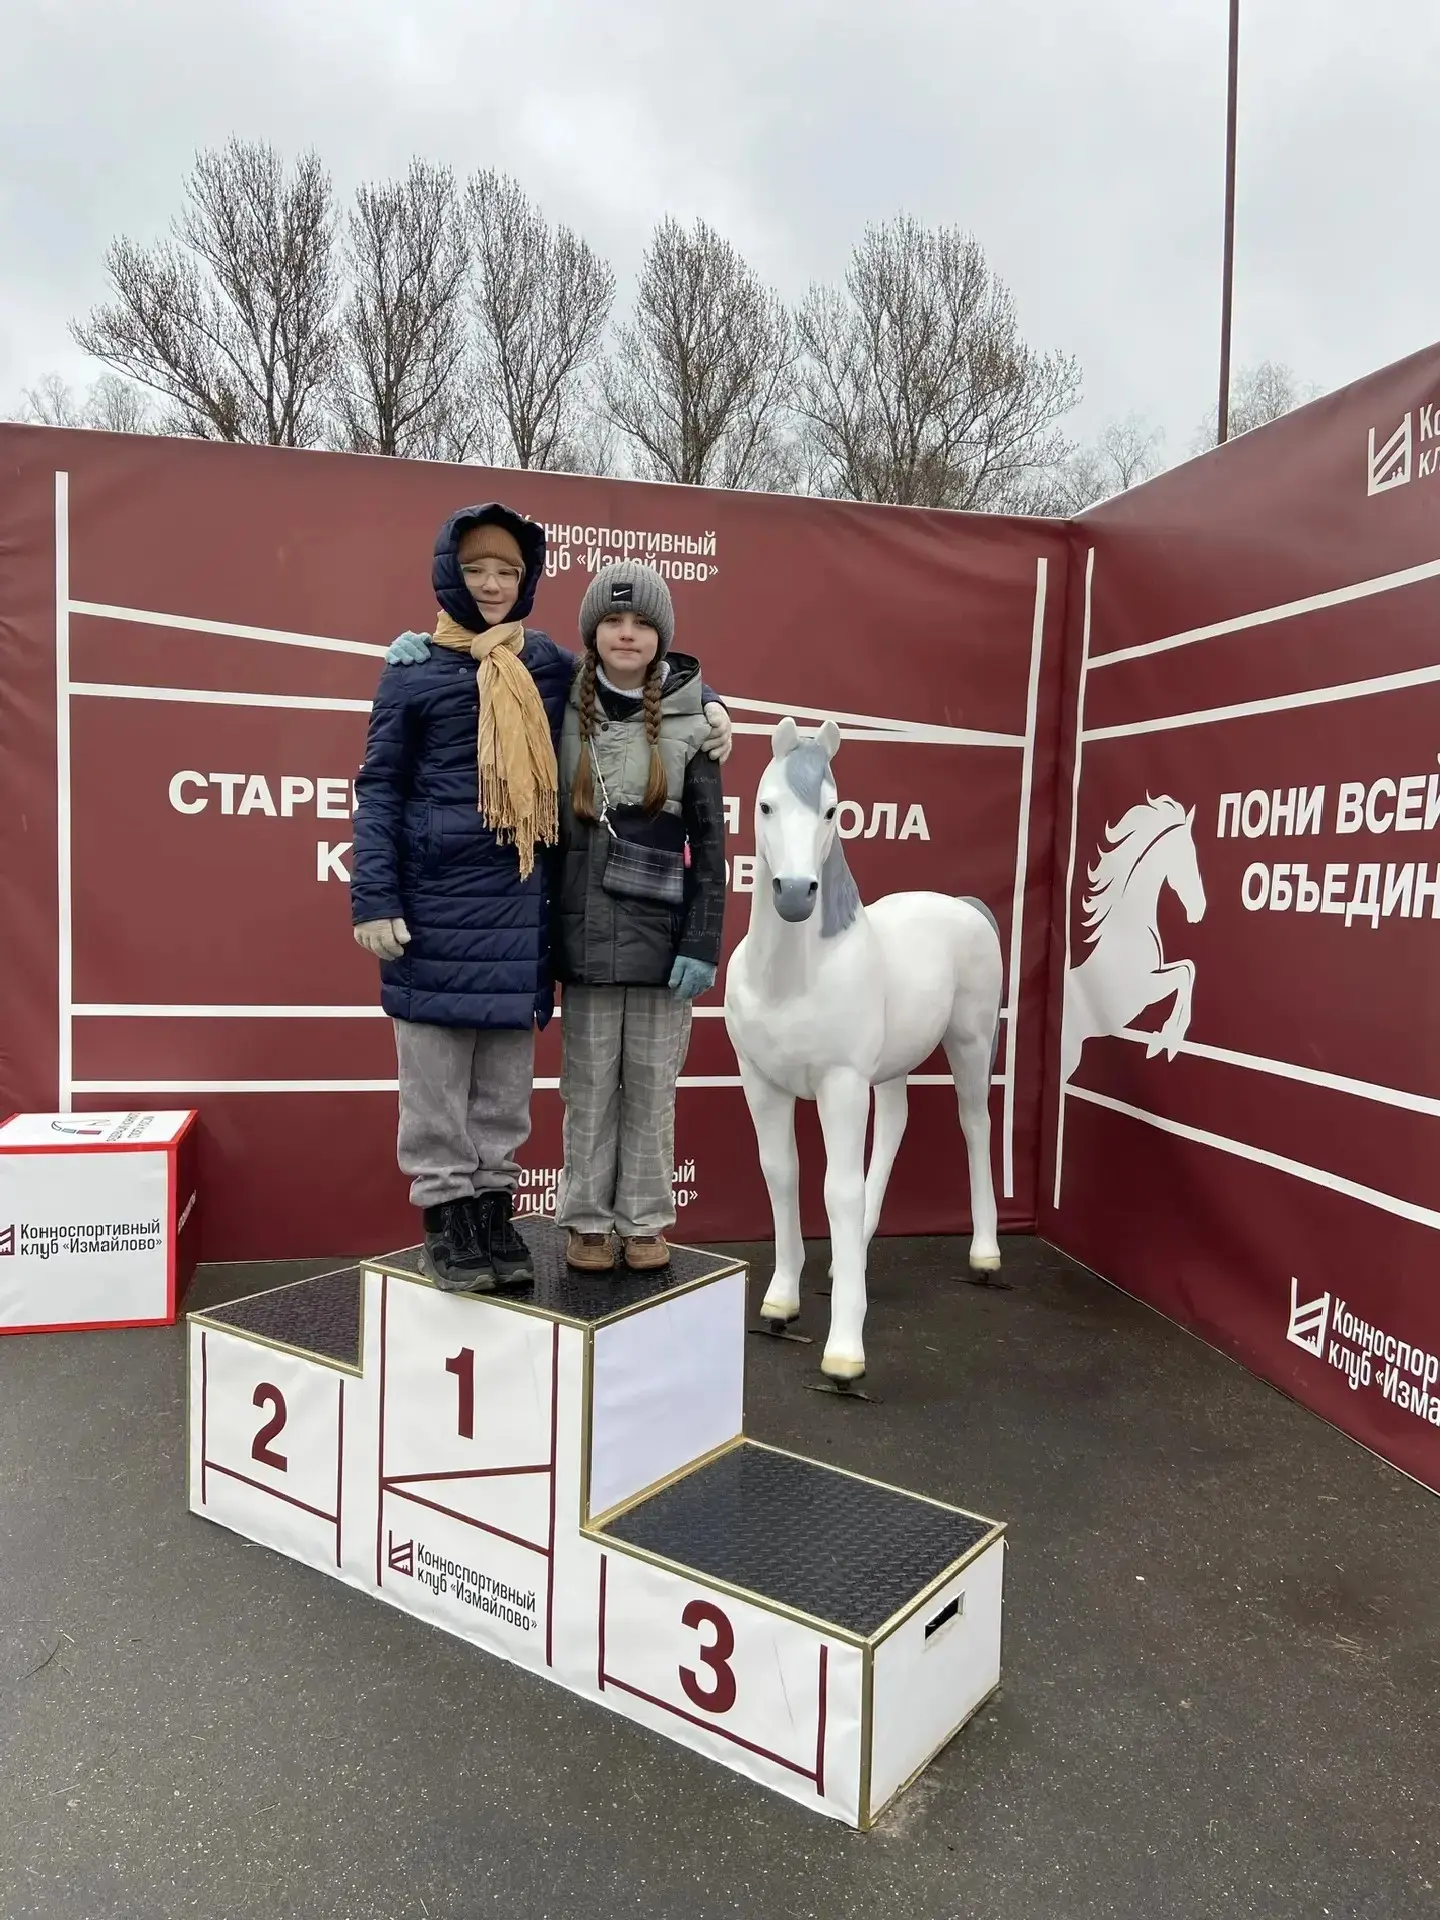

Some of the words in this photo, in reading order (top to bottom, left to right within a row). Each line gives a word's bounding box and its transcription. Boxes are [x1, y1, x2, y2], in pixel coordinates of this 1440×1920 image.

[519, 513, 717, 557] нноспортивный
[545, 543, 571, 578] уб
[168, 764, 361, 819] СТАРЕ
[836, 800, 931, 841] ОЛА
[1216, 784, 1326, 839] ПОНИ
[1241, 861, 1440, 930] ОБЪЕДИН
[20, 1218, 160, 1241] Конноспортивный
[20, 1237, 59, 1260] клуб
[63, 1237, 163, 1254] «Измайлово»
[445, 1346, 475, 1441] 1
[1328, 1339, 1372, 1391] клуб
[251, 1381, 289, 1473] 2
[417, 1542, 536, 1613] Конноспортивный
[417, 1567, 448, 1596] клуб
[450, 1579, 538, 1632] «Измайлово»
[678, 1599, 737, 1714] 3
